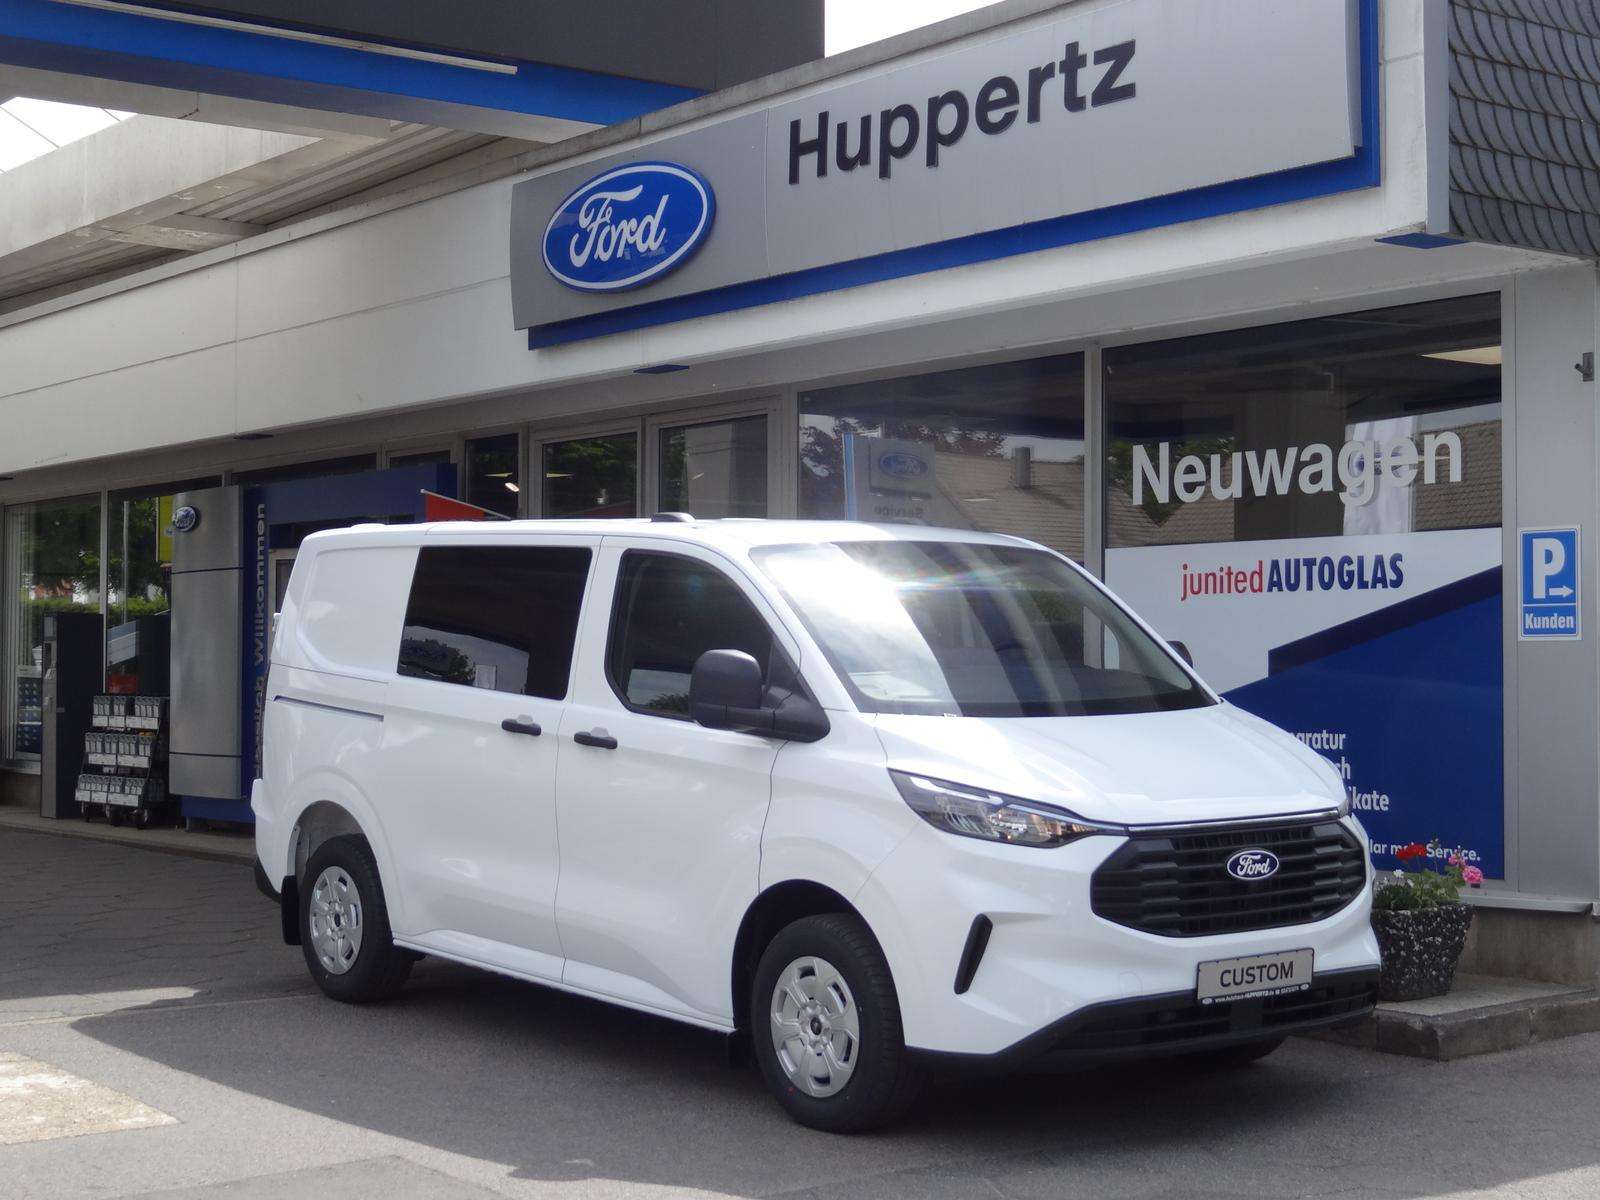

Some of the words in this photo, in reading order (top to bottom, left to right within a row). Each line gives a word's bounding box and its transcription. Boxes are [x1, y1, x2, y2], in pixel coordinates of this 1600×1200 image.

[788, 38, 1137, 186] Huppertz
[569, 184, 670, 268] Ford
[1131, 428, 1463, 507] Neuwagen
[1181, 560, 1263, 601] junited
[1266, 553, 1404, 592] AUTOGLAS
[1532, 538, 1565, 599] P
[1525, 613, 1574, 629] Kunden
[1291, 729, 1347, 750] aratur
[1347, 786, 1390, 811] kate
[1237, 853, 1271, 876] Ford
[1220, 961, 1294, 988] CUSTOM
